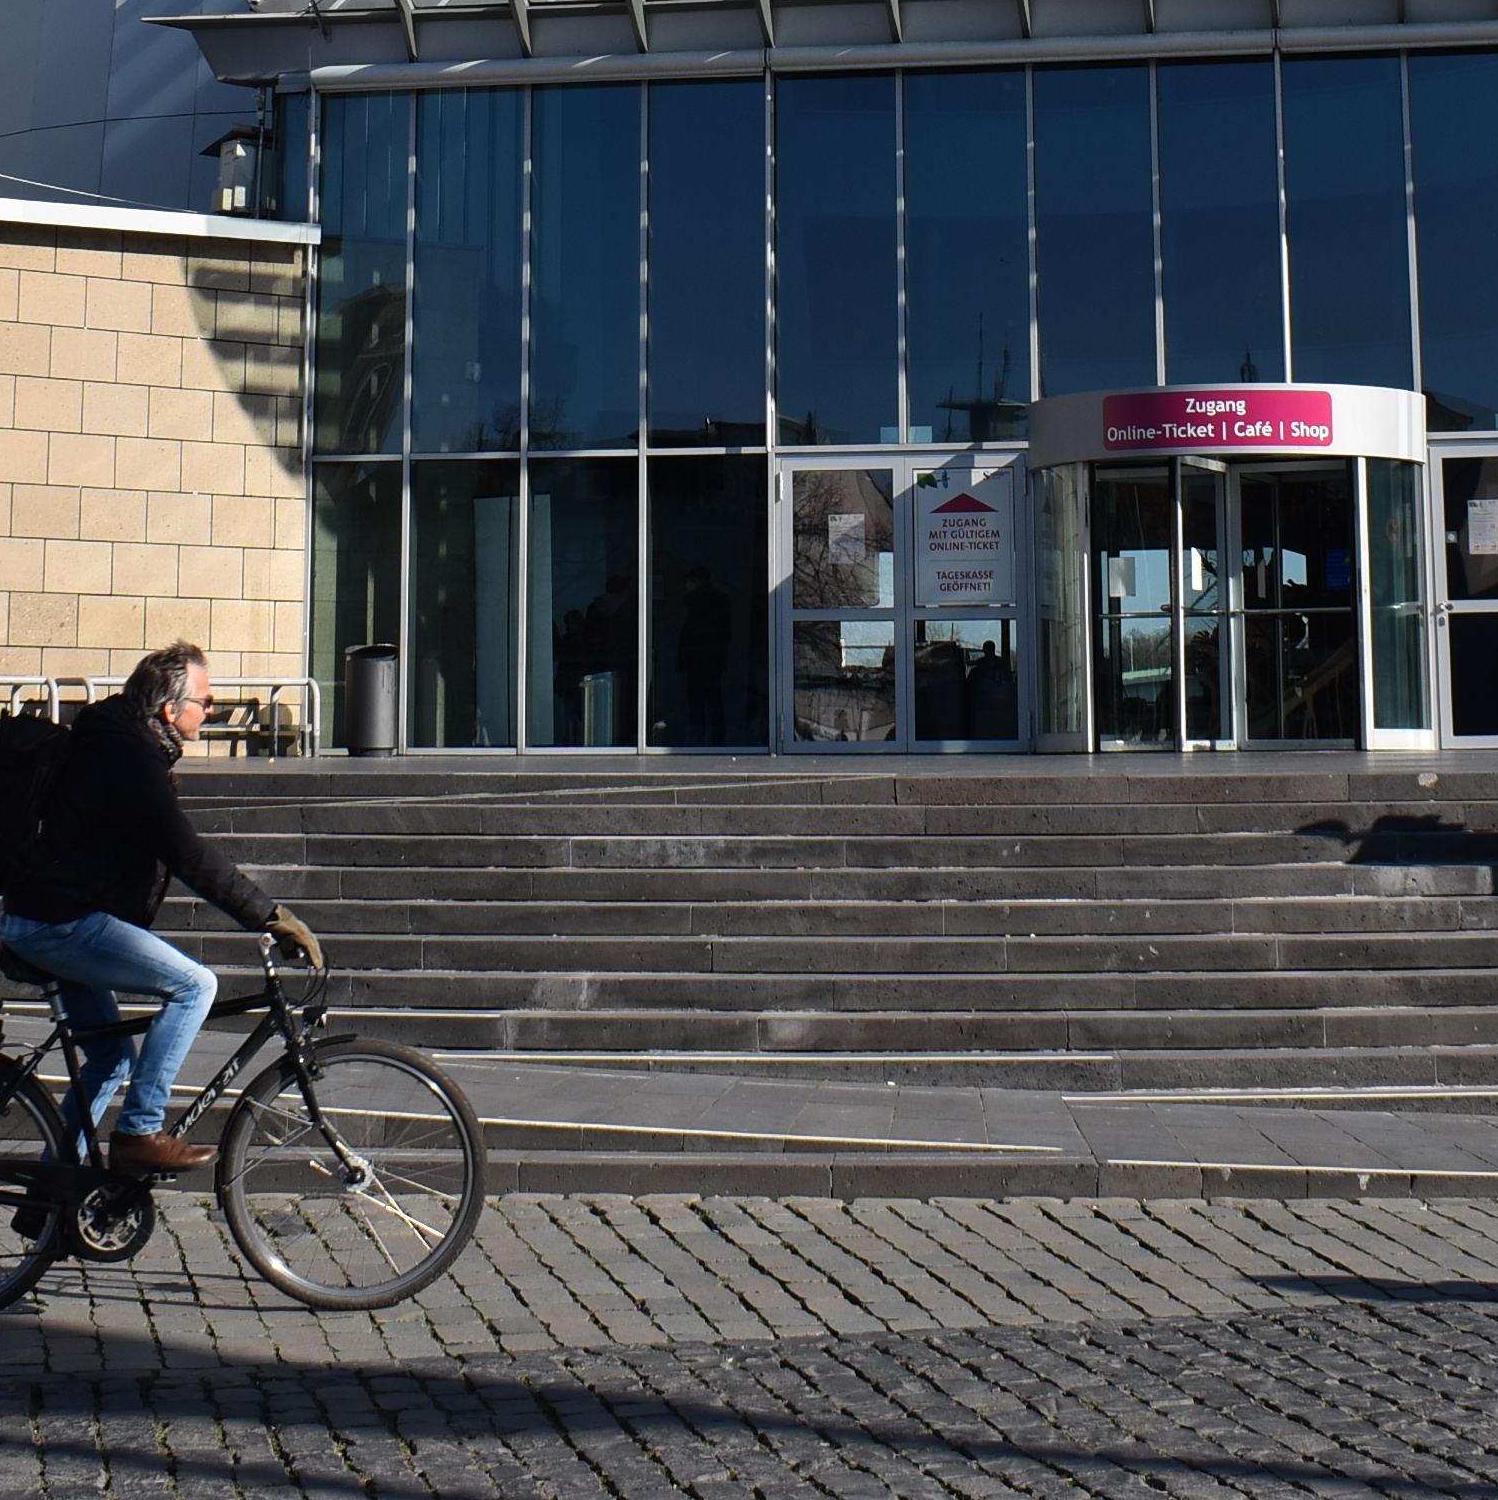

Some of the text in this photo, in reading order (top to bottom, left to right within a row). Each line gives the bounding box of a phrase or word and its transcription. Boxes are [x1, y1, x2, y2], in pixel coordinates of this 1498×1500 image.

[1185, 398, 1246, 415] Zugang
[1107, 423, 1215, 442] Online-Ticket
[1234, 421, 1273, 437] Café
[1291, 421, 1329, 441] Shop
[942, 518, 986, 527] ZUGANG
[929, 528, 1000, 539] MIT GÜLTIGEM
[929, 541, 1000, 551] ONLINE-TICKET
[936, 570, 994, 580] TAGESKASSE
[940, 581, 991, 591] GEÖFFNET!
